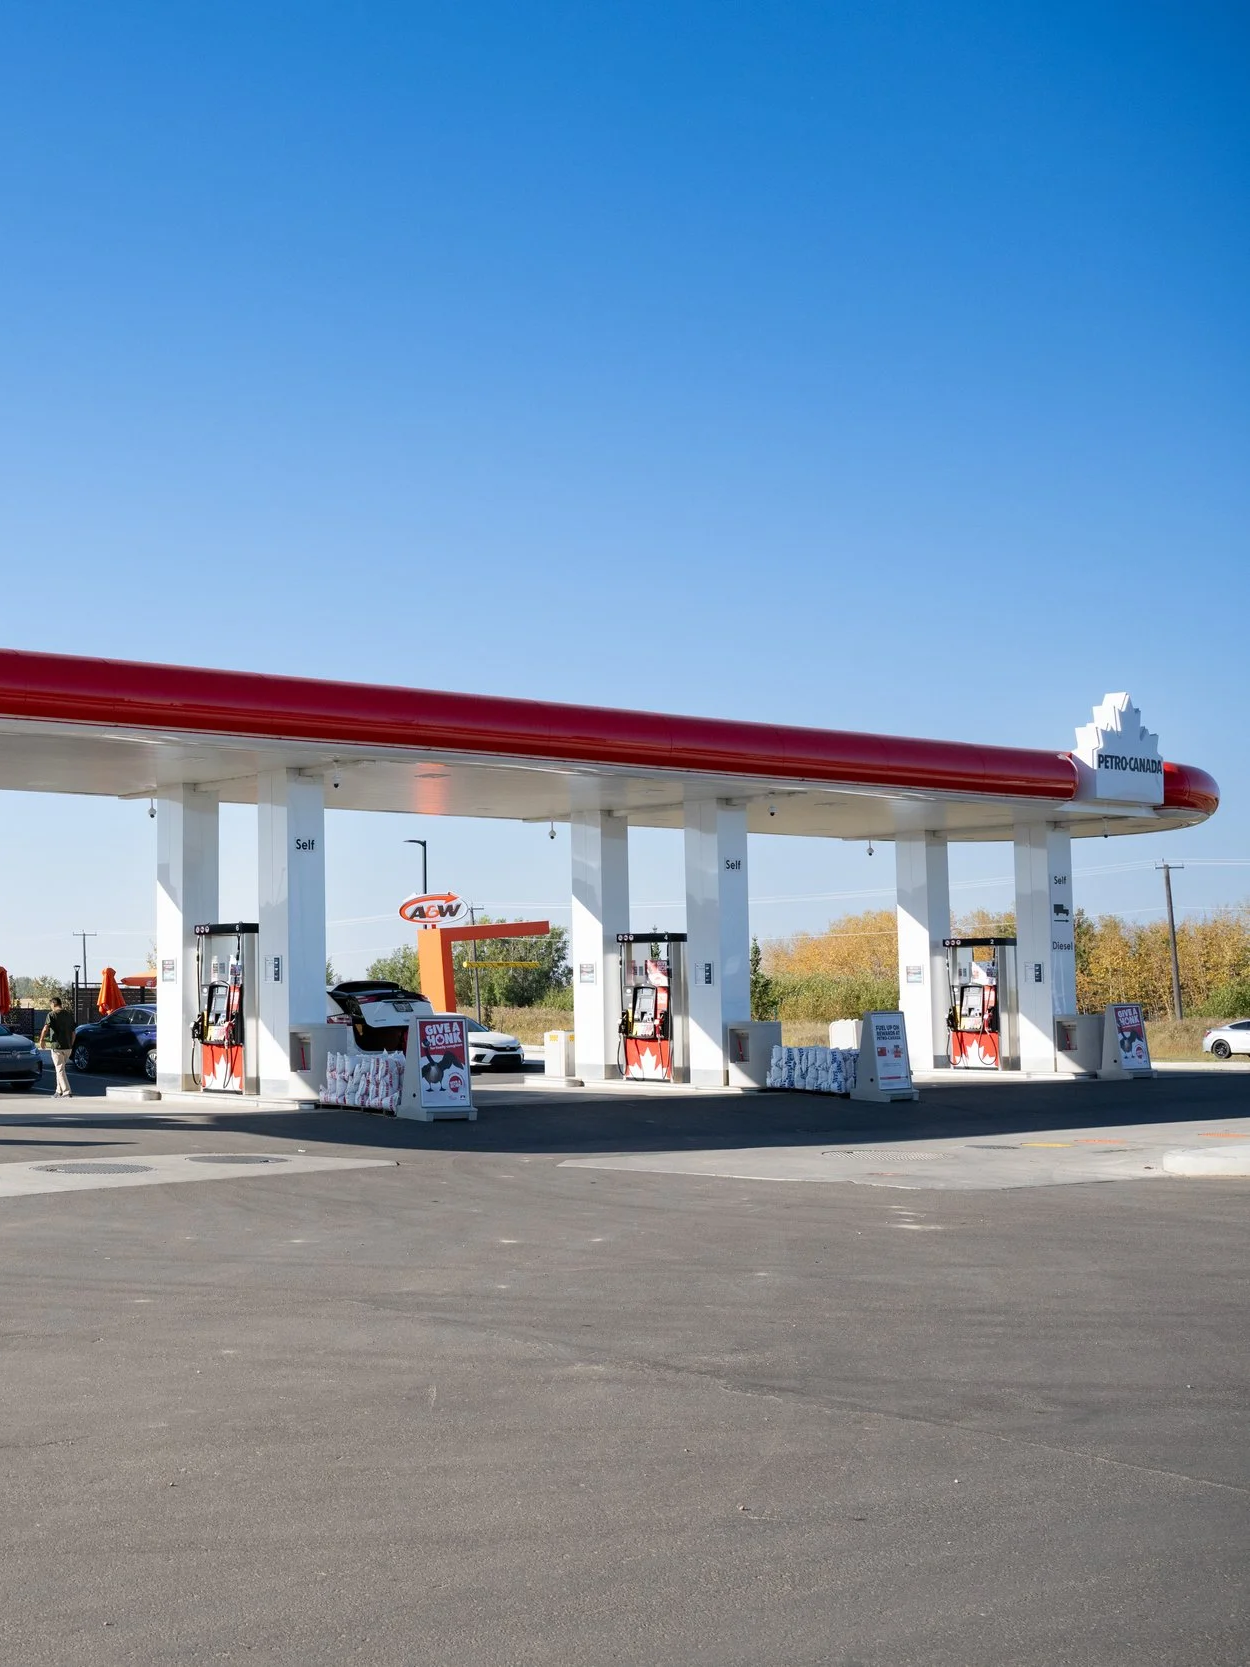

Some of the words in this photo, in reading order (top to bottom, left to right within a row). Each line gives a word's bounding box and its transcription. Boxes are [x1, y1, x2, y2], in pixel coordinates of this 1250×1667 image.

[296, 839, 315, 850] Self
[726, 860, 741, 870] Self
[1054, 876, 1067, 884] Self
[409, 903, 462, 919] A&W
[1052, 941, 1073, 950] Diesel
[1117, 1009, 1131, 1018] GIVE
[425, 1023, 451, 1035] GIVE
[453, 1022, 460, 1032] A
[426, 1032, 462, 1046] HONK
